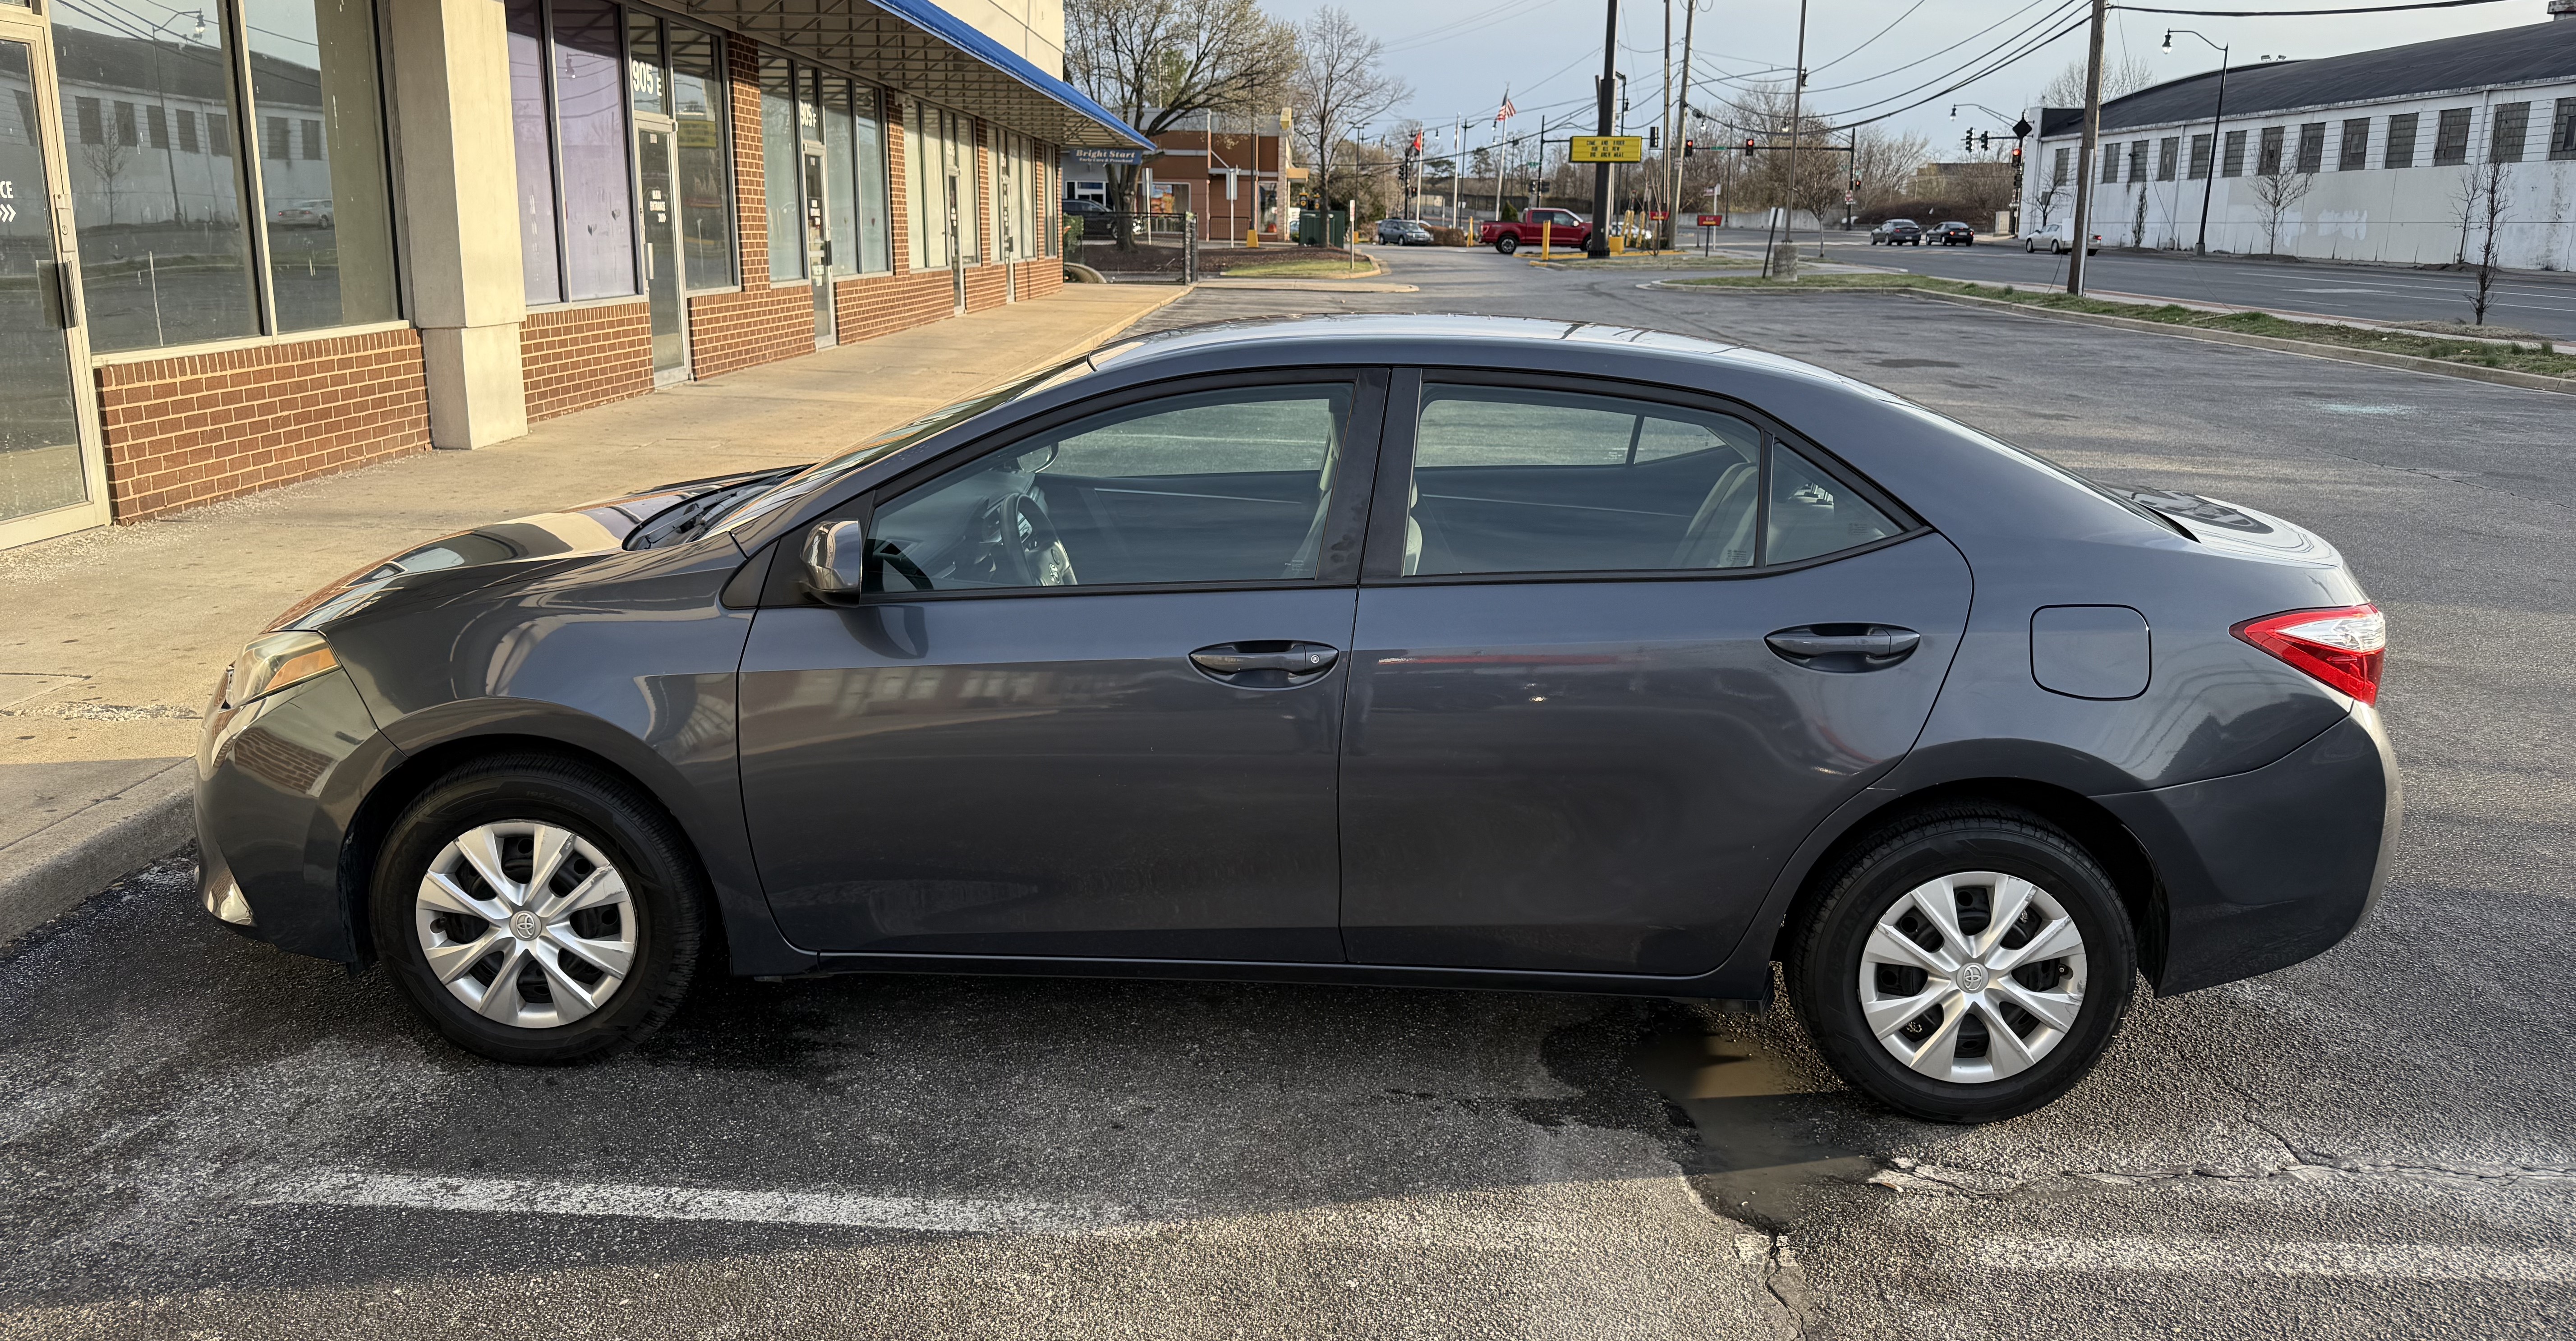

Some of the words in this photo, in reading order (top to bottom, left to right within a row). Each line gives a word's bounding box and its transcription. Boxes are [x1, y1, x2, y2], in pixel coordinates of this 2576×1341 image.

[632, 60, 654, 95] 905
[657, 77, 662, 97] E
[1076, 150, 1107, 158] Bright
